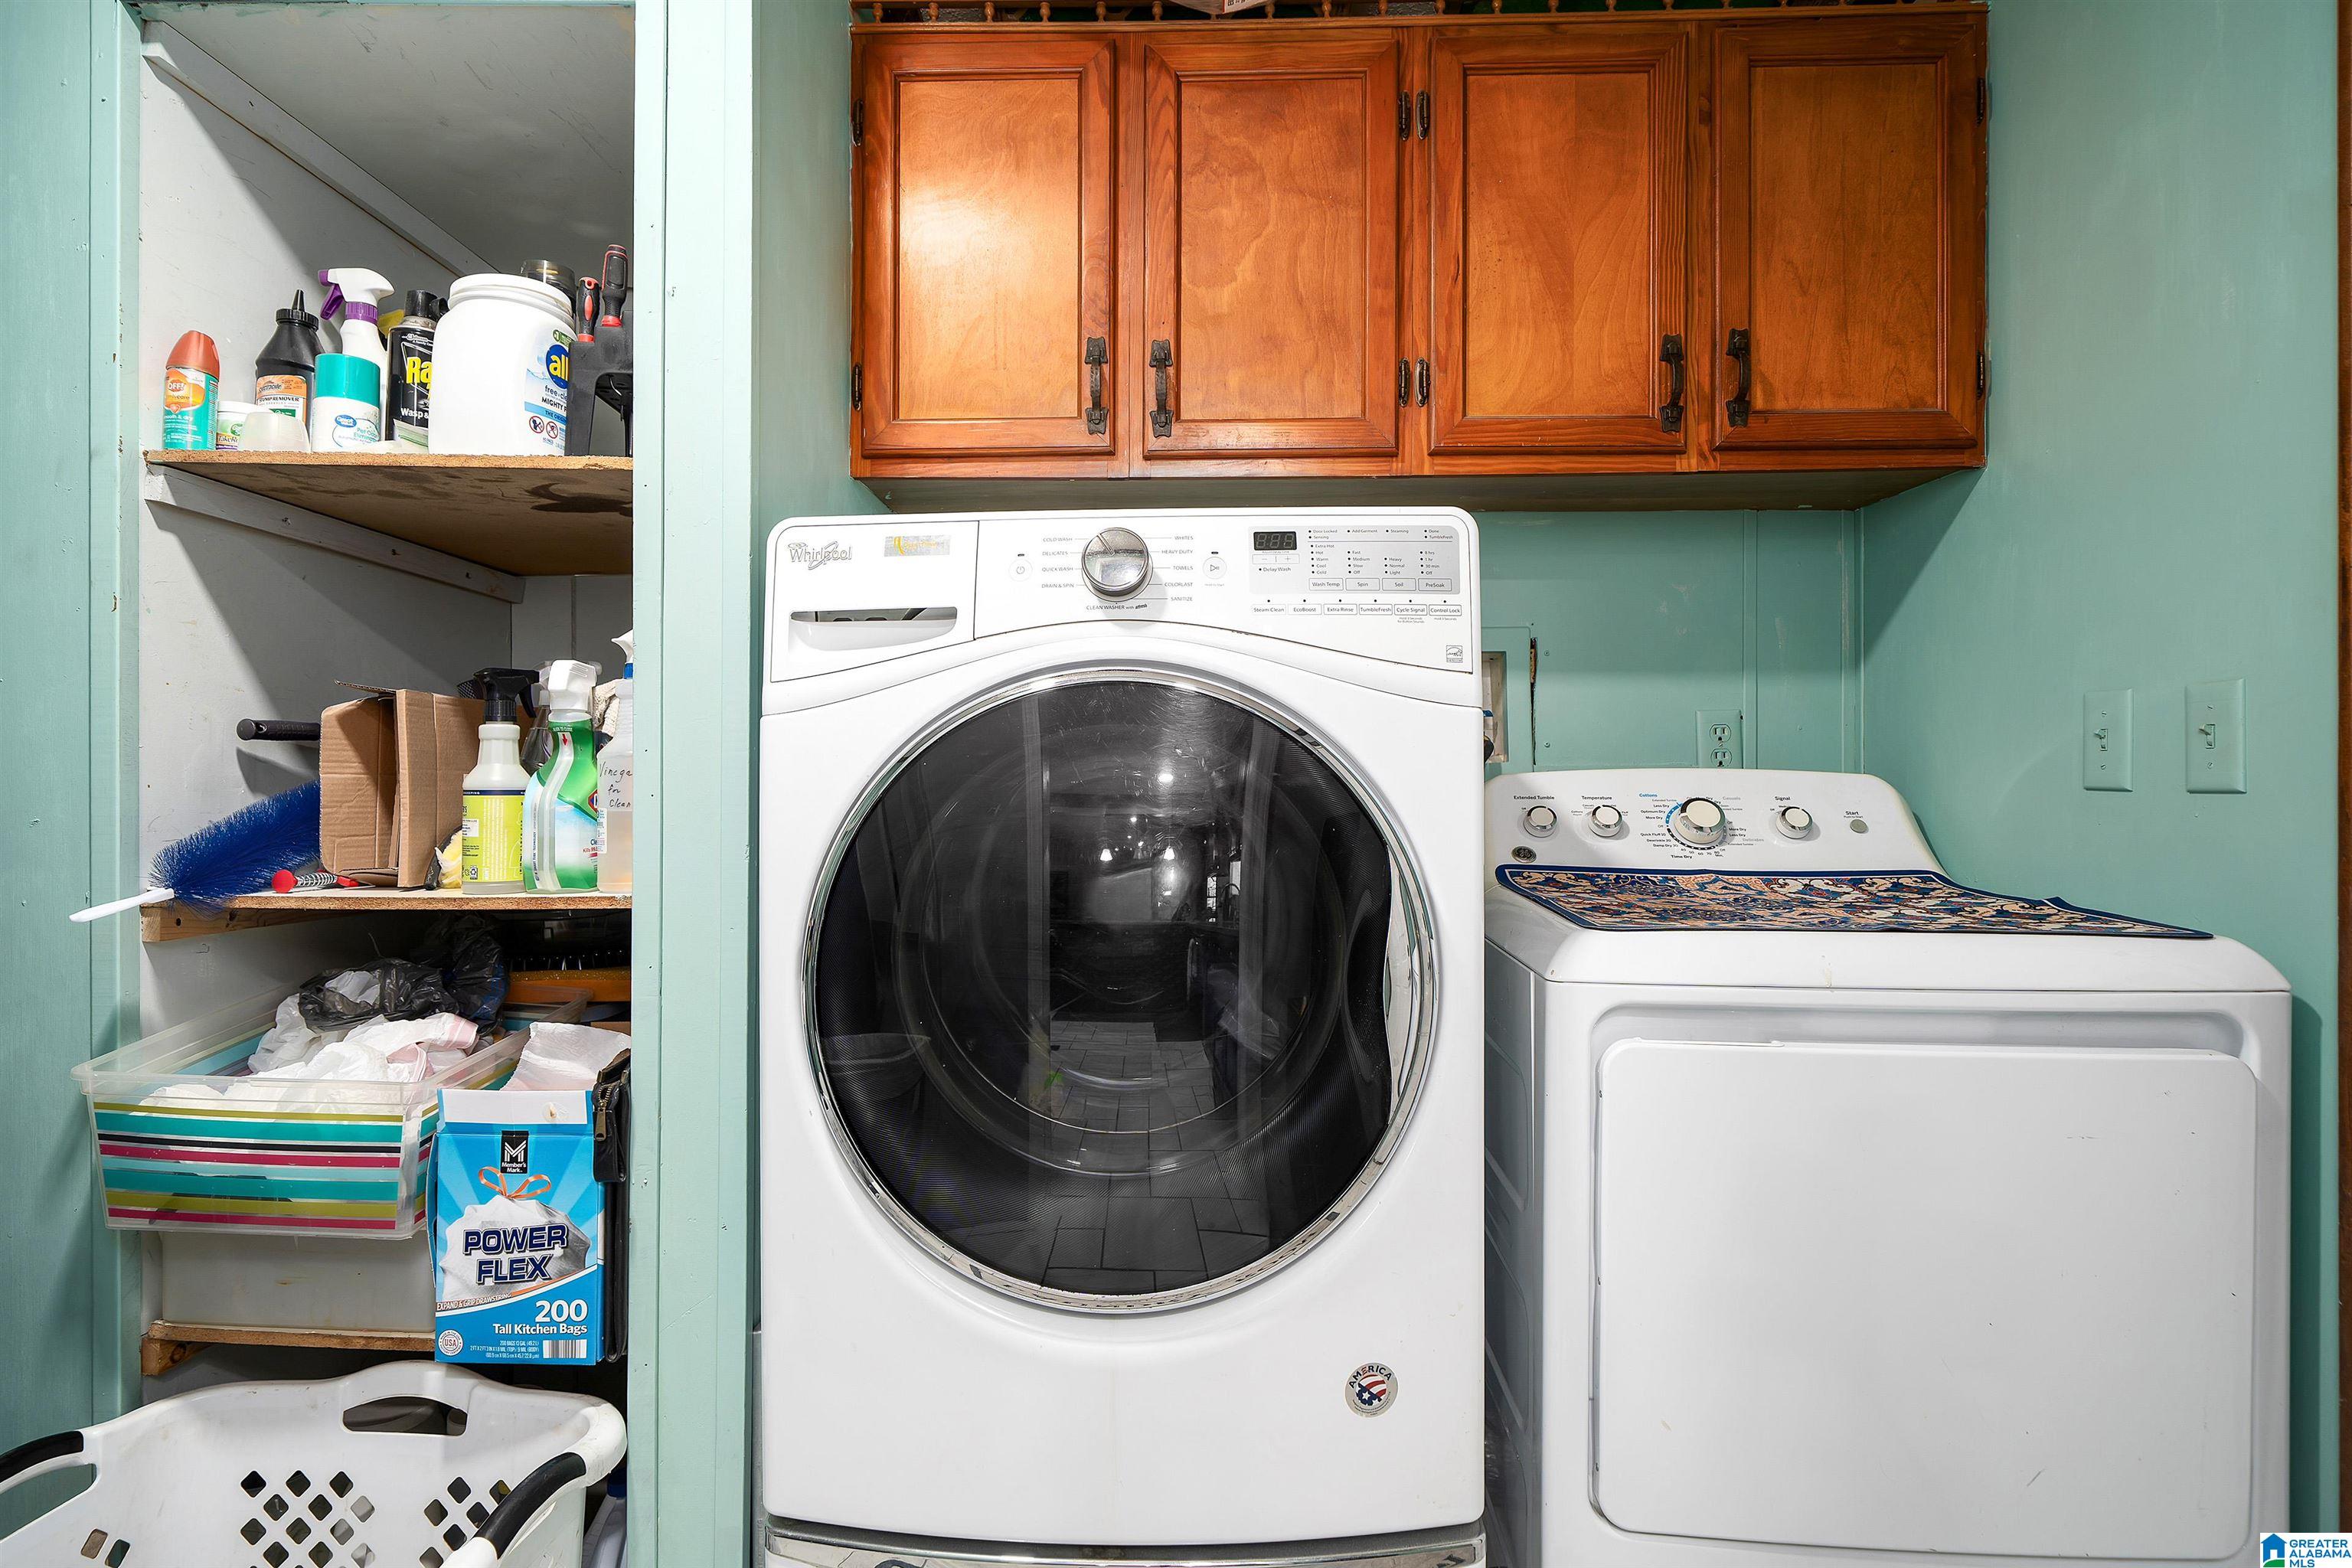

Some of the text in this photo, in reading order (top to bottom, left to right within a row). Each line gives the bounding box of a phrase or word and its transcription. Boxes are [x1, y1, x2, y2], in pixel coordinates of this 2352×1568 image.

[549, 354, 570, 381] all
[168, 382, 185, 390] OFF!
[544, 384, 558, 397] free
[541, 397, 564, 412] MIGHTY
[400, 407, 423, 420] Wasp
[545, 410, 554, 418] THE
[789, 544, 852, 567] Whirlpool
[608, 784, 621, 795] for
[609, 799, 631, 808] Clean
[462, 1223, 570, 1256] POWER
[475, 1253, 554, 1285] FLEX
[436, 1301, 459, 1311] EXPAND
[475, 1292, 511, 1305] DRAWSTRING
[534, 1298, 589, 1323] 200
[492, 1323, 588, 1336] Tall Kitchen Bags
[444, 1338, 457, 1347] USA
[1348, 1365, 1392, 1389] AMERICA
